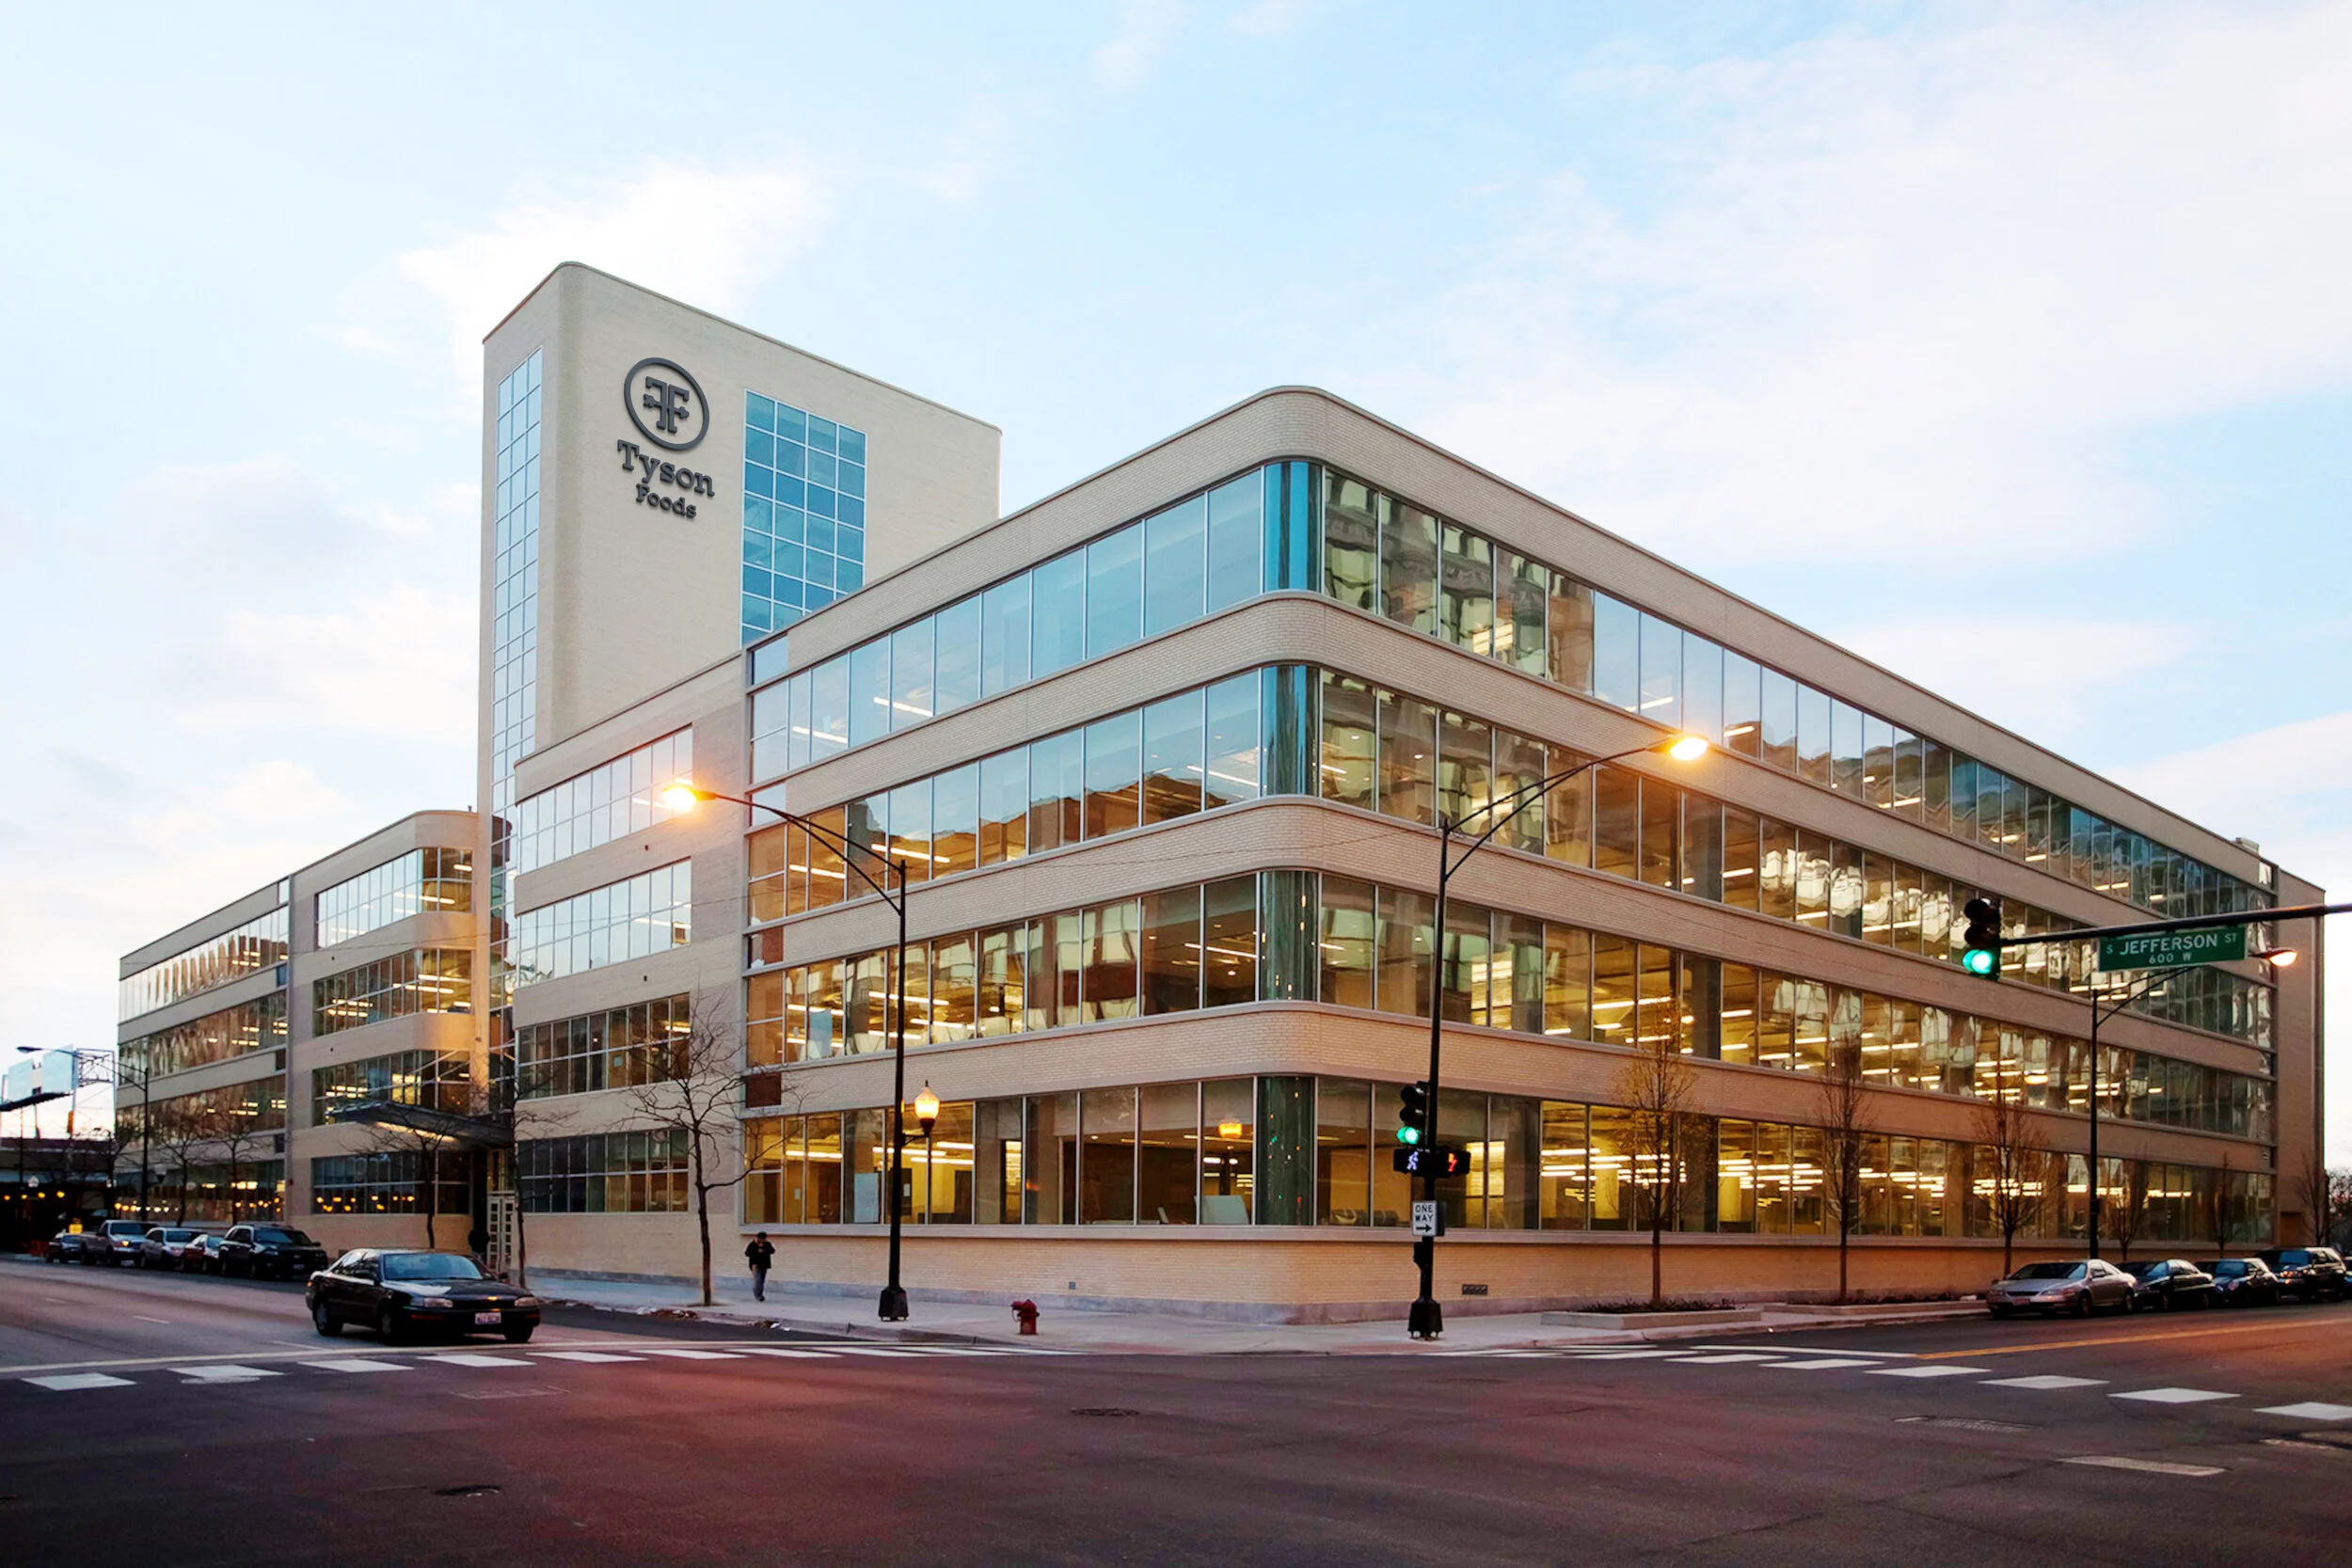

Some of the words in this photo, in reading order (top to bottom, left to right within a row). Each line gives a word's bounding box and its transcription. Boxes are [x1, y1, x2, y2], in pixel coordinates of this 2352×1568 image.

[617, 439, 715, 497] Tyson
[636, 483, 697, 518] Foods
[2106, 943, 2114, 955] S
[2119, 933, 2217, 956] JEFFERSON
[2224, 932, 2237, 943] ST
[2149, 953, 2174, 964] 600
[2183, 952, 2192, 961] W
[1415, 1204, 1434, 1213] ONE
[1415, 1213, 1434, 1222] WAY
